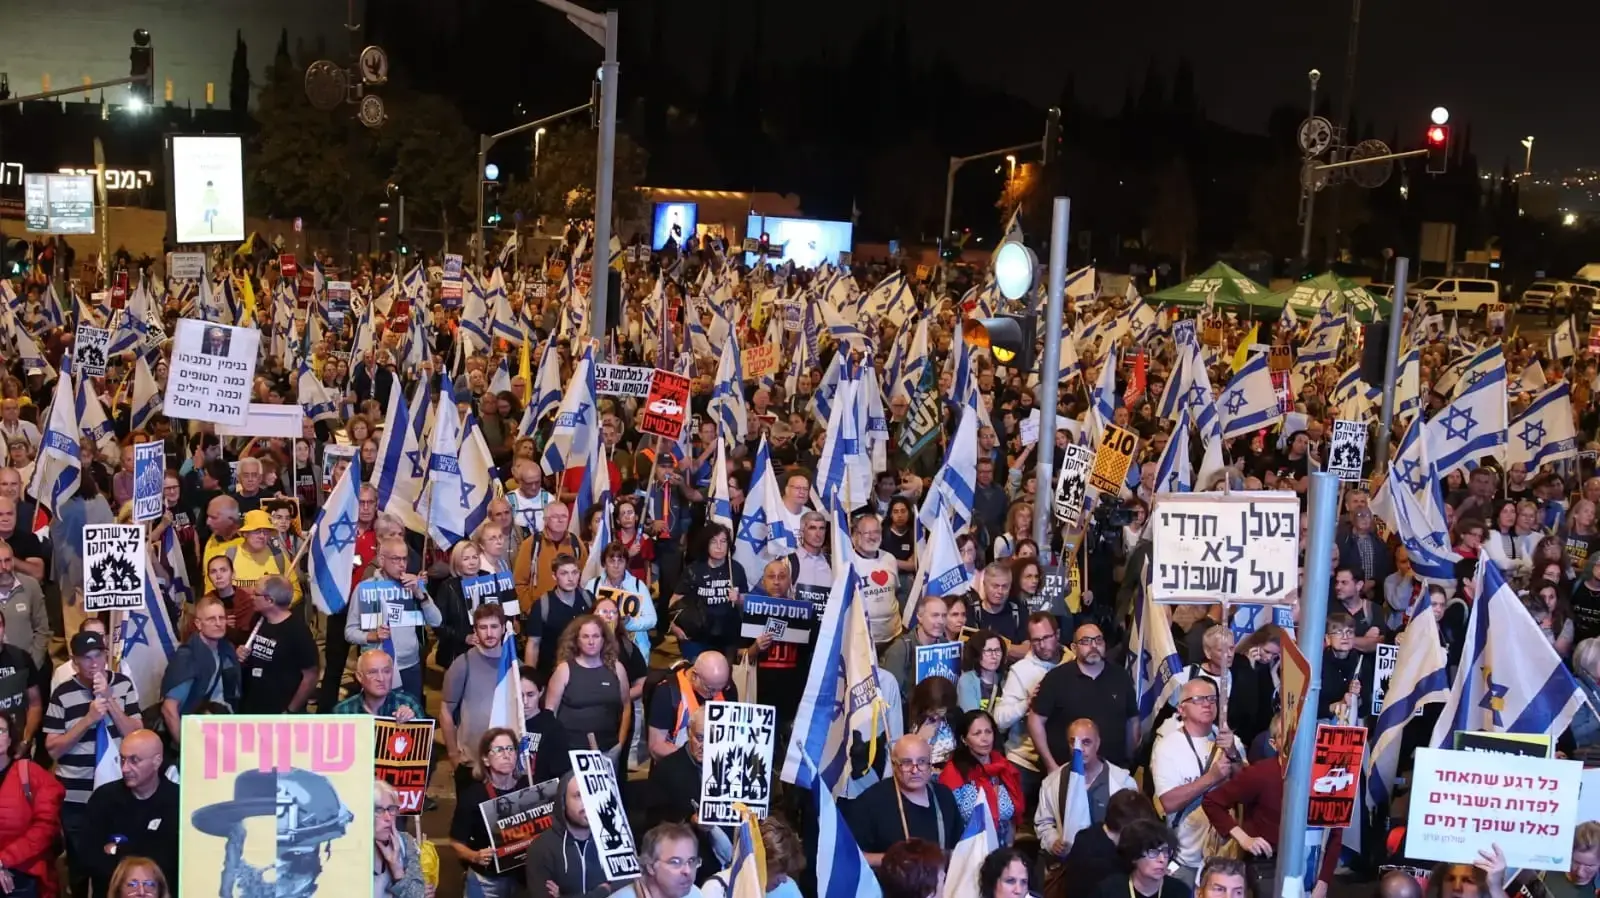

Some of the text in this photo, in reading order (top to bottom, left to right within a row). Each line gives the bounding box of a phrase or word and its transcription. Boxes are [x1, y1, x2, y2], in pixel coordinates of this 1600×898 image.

[178, 353, 248, 371] בנימין נתניהו
[180, 369, 246, 386] כמה חטופים
[595, 364, 607, 379] על
[610, 367, 643, 381] למלחמה
[177, 383, 242, 400] וכמה חיילים
[609, 380, 621, 391] של
[173, 394, 240, 415] הרגת היום?
[1103, 424, 1135, 456] 7.10
[85, 527, 140, 541] מי שהרס
[87, 540, 139, 556] לא יתקן
[1250, 559, 1284, 597] על
[918, 645, 961, 663] בחירות
[708, 704, 773, 726] מי שהס
[748, 726, 772, 746] לא
[202, 723, 356, 780] שיוויון
[576, 754, 607, 772] הרס
[1435, 769, 1559, 791] כל רגע שמאחר
[704, 801, 742, 820] כשיו!
[1429, 792, 1560, 813] לפדות השבויים
[1424, 814, 1560, 836] כאלו שופך דמים
